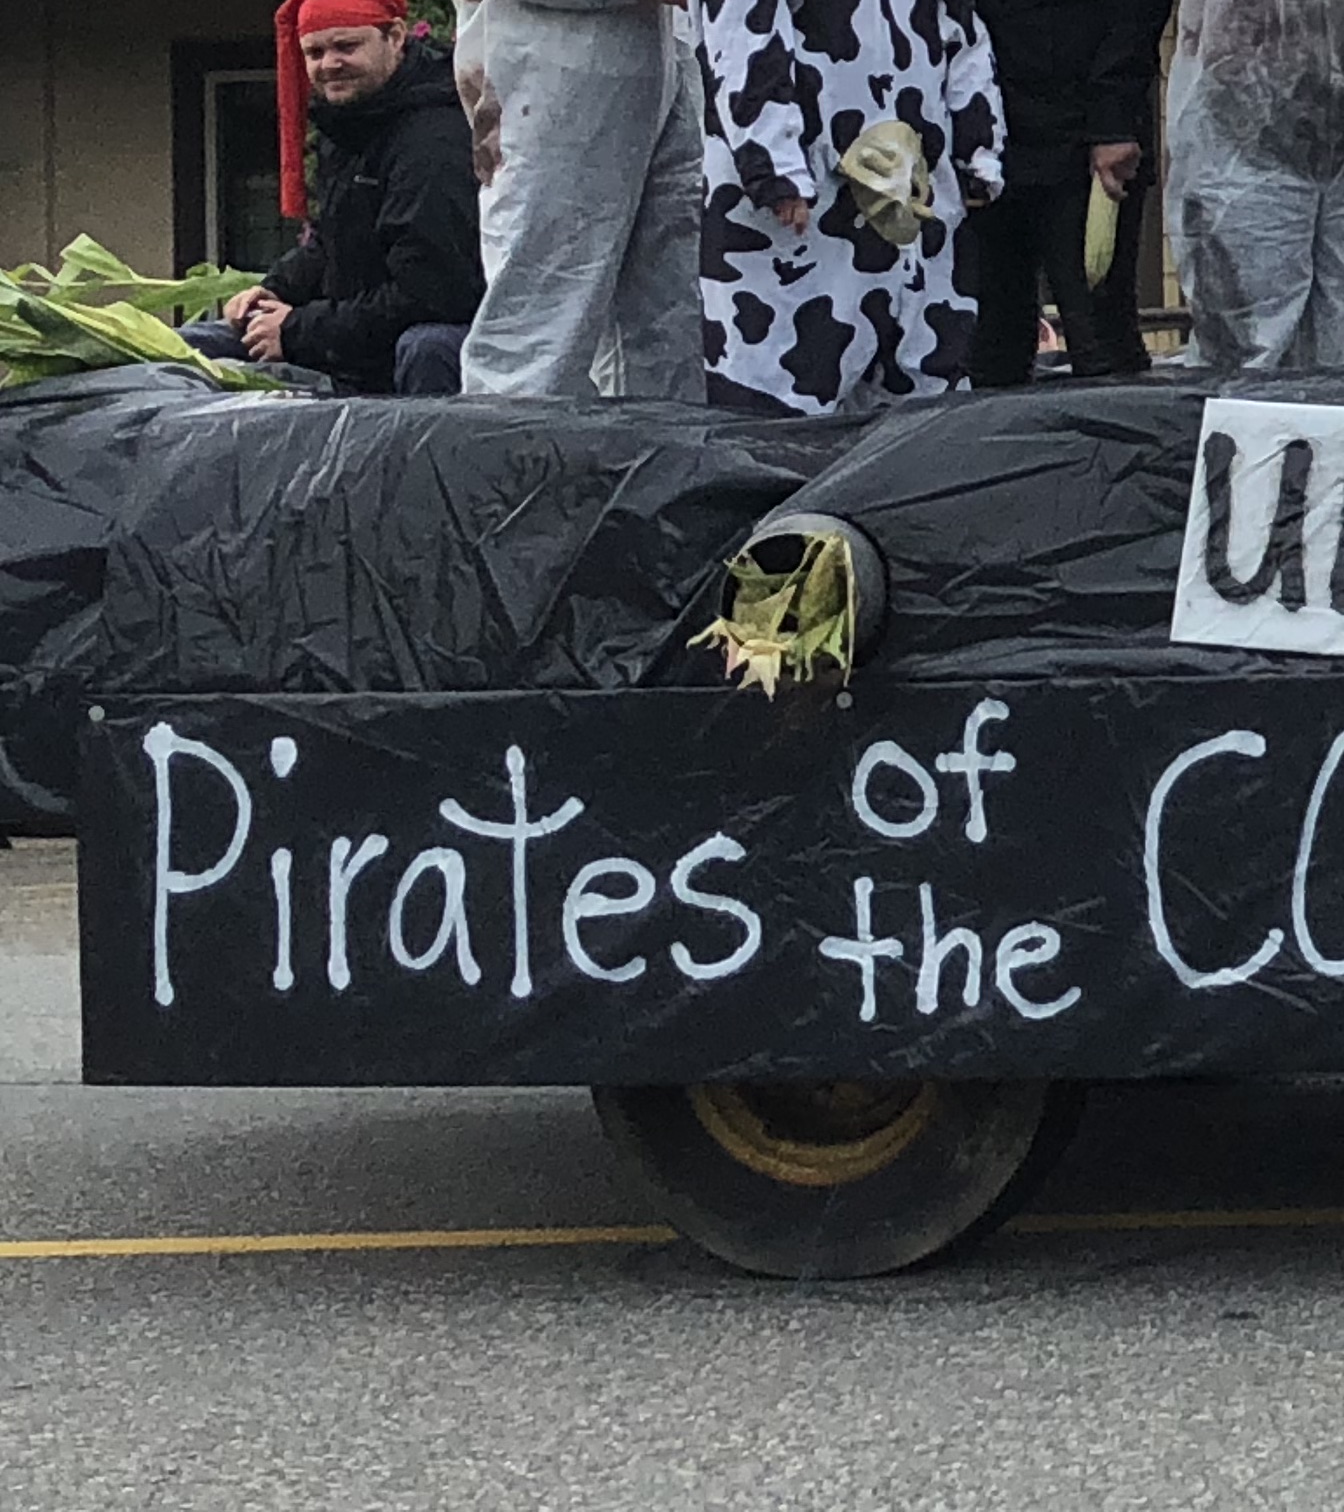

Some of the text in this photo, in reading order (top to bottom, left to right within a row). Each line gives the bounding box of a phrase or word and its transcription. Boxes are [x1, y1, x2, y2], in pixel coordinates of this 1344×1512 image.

[851, 698, 1017, 844] of
[142, 721, 763, 1008] Pirates
[818, 876, 1083, 1022] the
